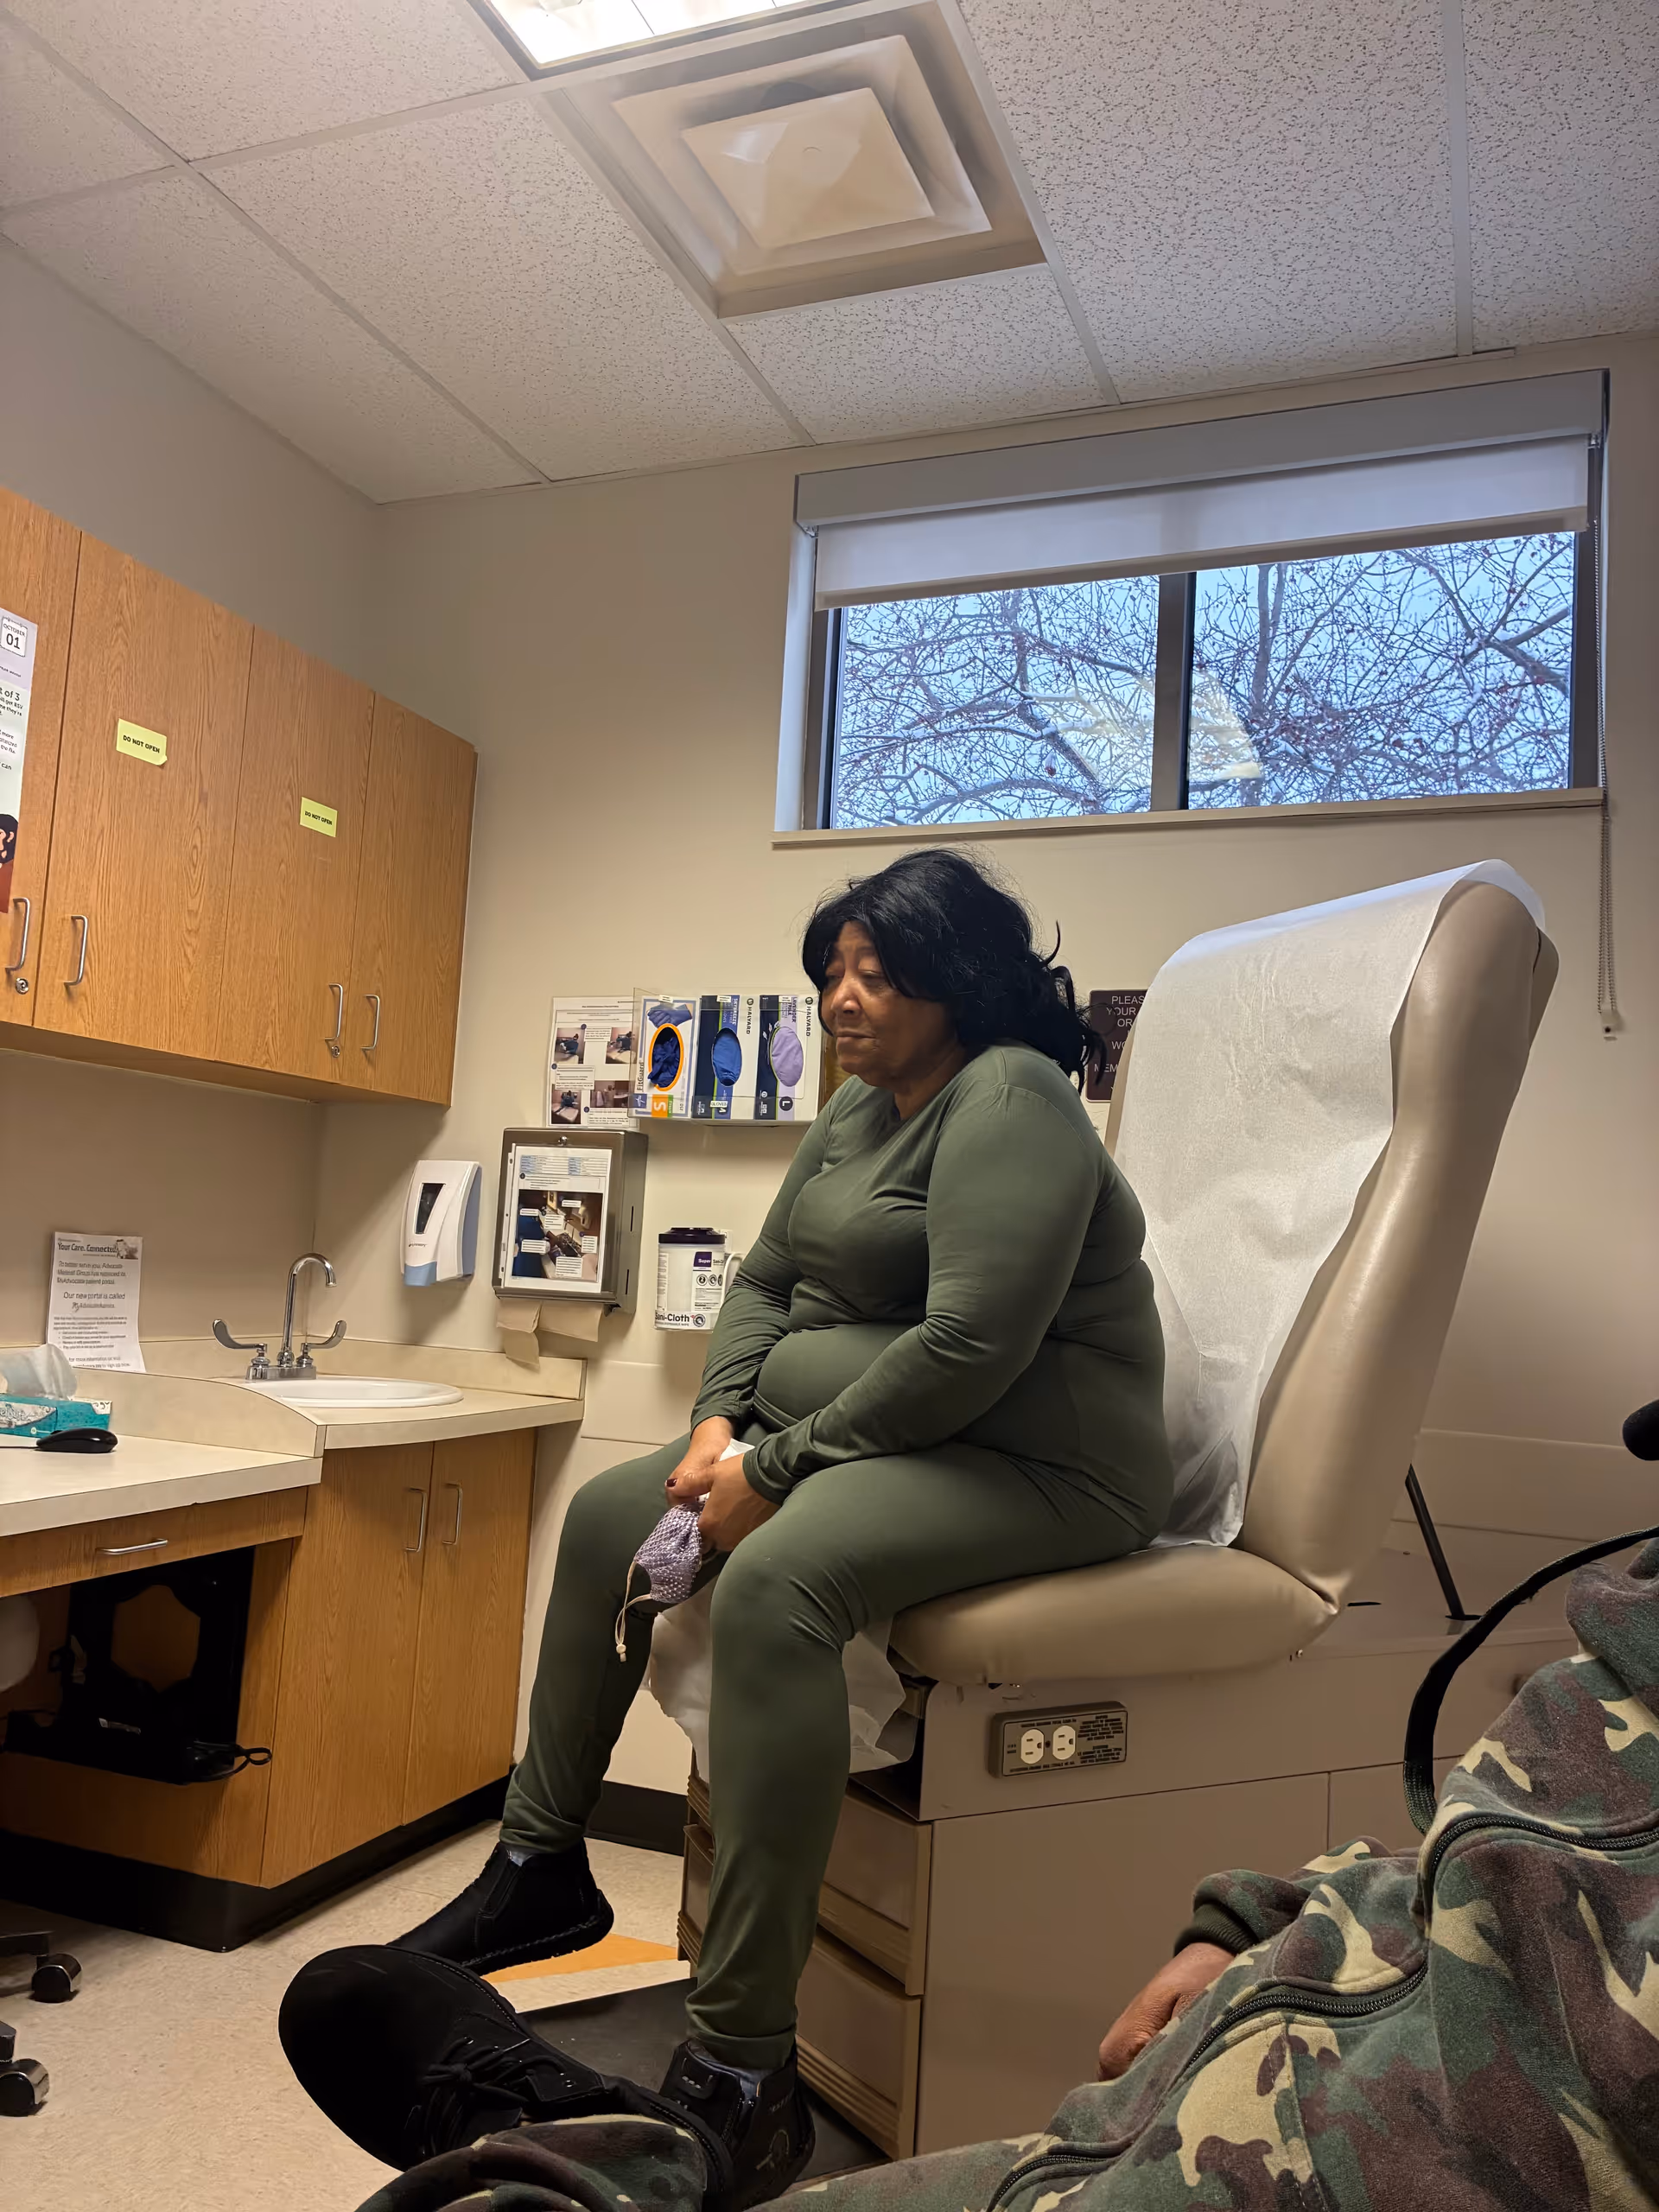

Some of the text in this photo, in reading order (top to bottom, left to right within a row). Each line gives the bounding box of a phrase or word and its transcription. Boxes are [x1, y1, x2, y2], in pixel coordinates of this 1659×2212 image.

[3, 623, 26, 637] OCTOBER
[6, 633, 20, 650] 01
[15, 692, 20, 701] 3
[132, 738, 144, 747] NOT
[145, 743, 160, 753] OPEN
[321, 817, 333, 825] OPEN
[1111, 995, 1145, 1005] PLEAS
[1106, 1007, 1136, 1016] YOUR
[654, 1102, 666, 1111] S
[655, 1313, 690, 1322] Sani-Cloth
